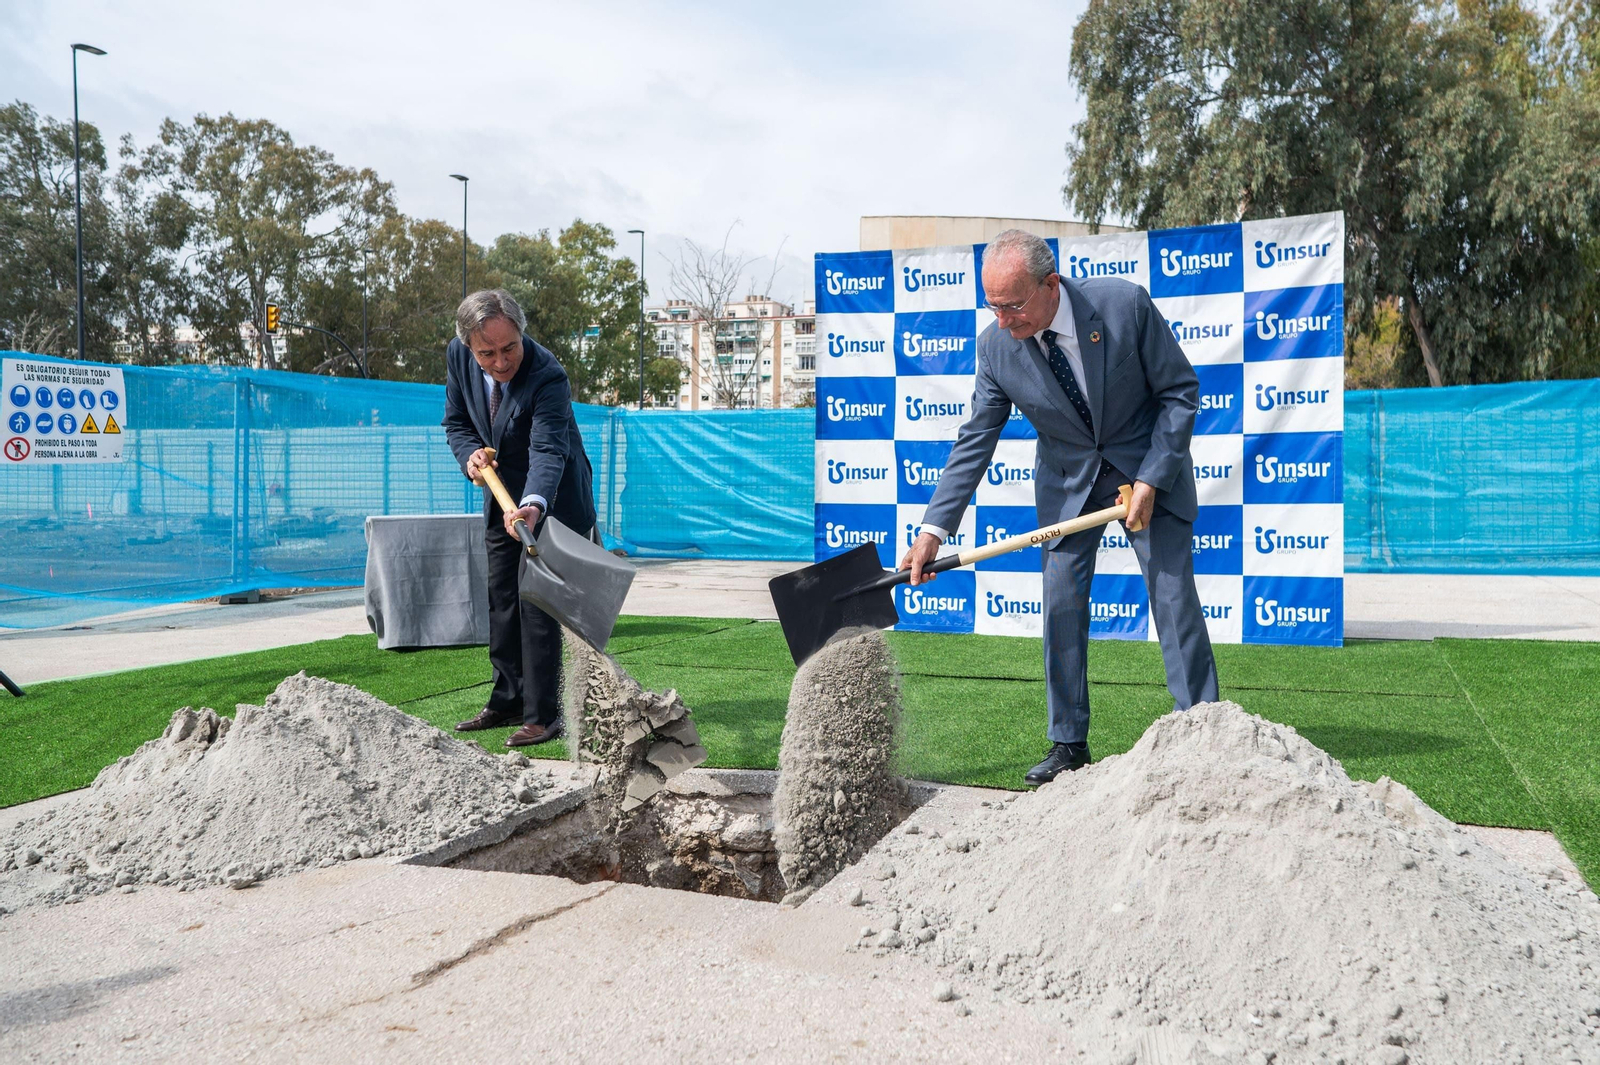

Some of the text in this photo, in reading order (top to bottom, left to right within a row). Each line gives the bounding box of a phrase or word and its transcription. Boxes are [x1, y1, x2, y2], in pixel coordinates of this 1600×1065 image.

[26, 364, 67, 374] OBLIGATORIO
[69, 368, 88, 376] SEGUIR
[37, 375, 60, 383] NORMAS
[72, 377, 104, 385] SEGURIDAD
[1031, 528, 1060, 544] ALYCO
